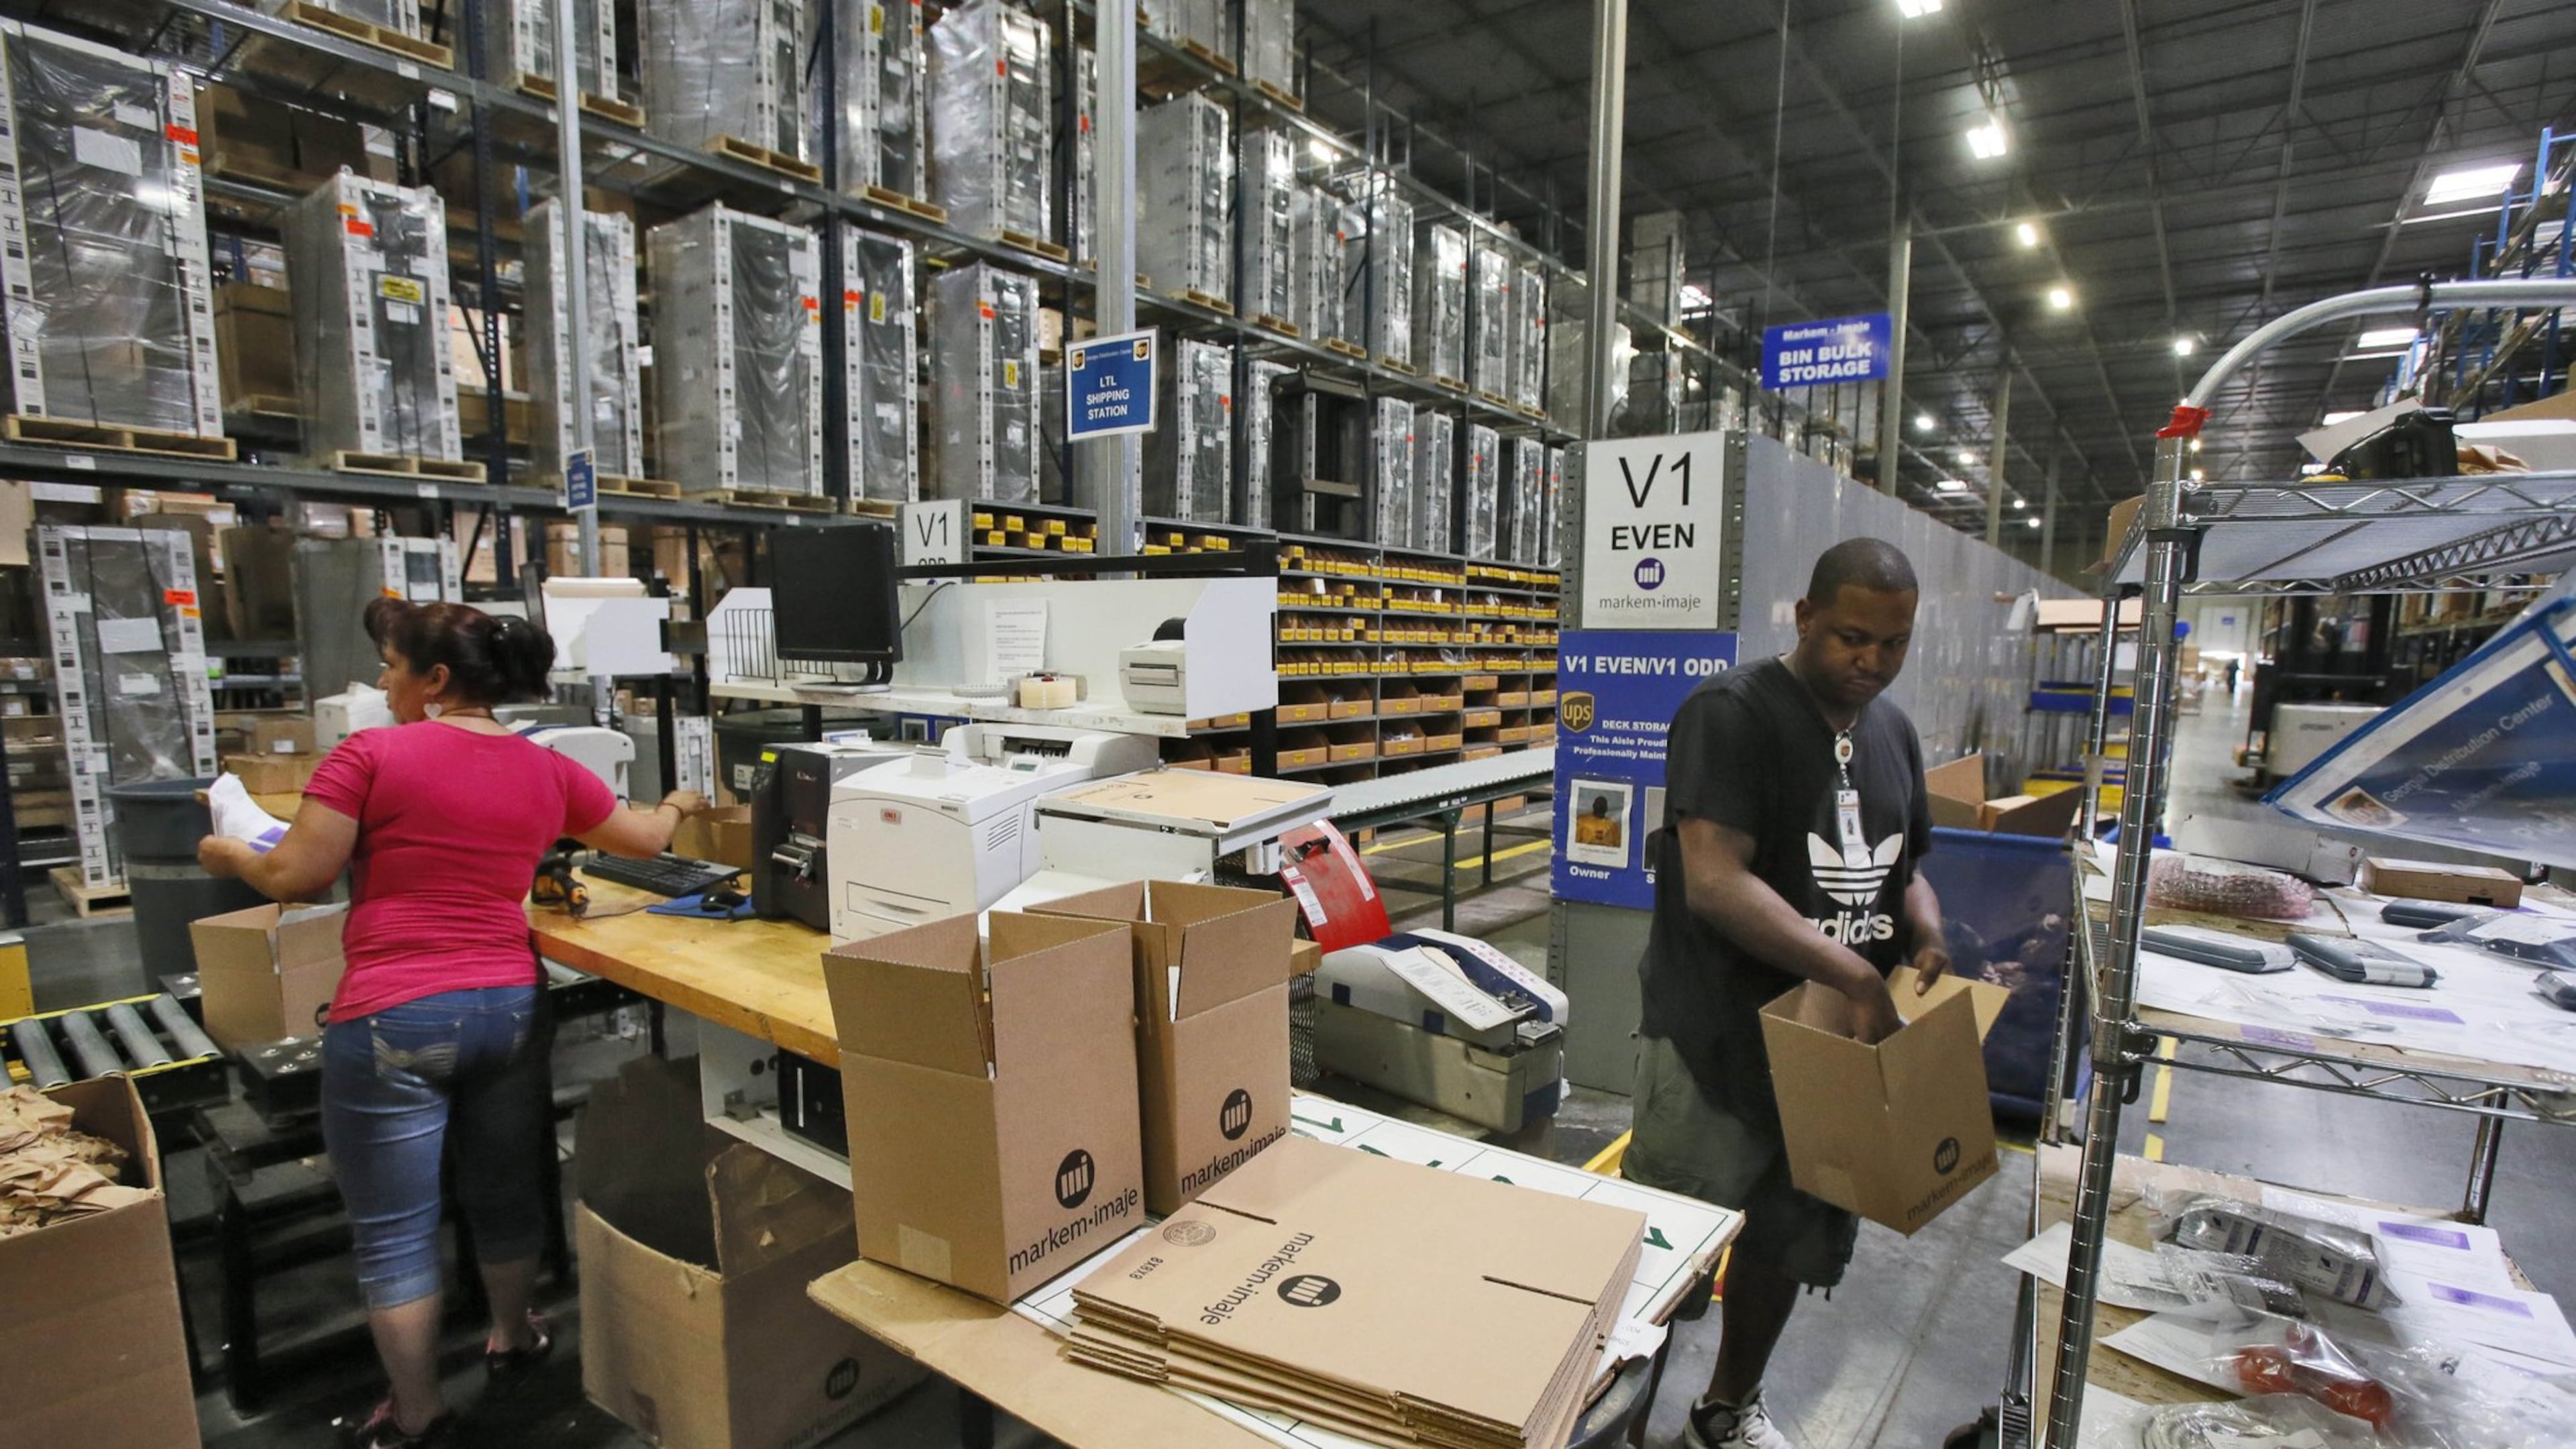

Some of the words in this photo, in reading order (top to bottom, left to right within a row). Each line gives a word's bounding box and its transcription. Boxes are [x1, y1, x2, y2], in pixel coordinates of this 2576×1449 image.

[1783, 327, 1827, 341] Markem
[1779, 349, 1813, 366] BIN
[1818, 341, 1872, 362] BULK
[1779, 360, 1870, 382] STORAGE
[1099, 376, 1117, 388] LTL
[1086, 389, 1129, 405] SHIPPING
[1087, 405, 1128, 420] STATION
[1619, 451, 1690, 508] V1
[916, 511, 947, 547] V1
[1612, 523, 1694, 550] EVEN
[1564, 655, 1587, 673] V1
[1595, 656, 1676, 675] EVEN/V1
[1684, 658, 1728, 676] ODD
[1563, 705, 1591, 727] ups
[1602, 720, 1629, 731] DECK
[1590, 735, 1609, 744] This
[1611, 737, 1635, 746] Aisle
[2383, 770, 2429, 804] Georgia
[2423, 726, 2501, 777] Distribution
[2499, 693, 2553, 732] Center
[1574, 747, 1637, 760] Professionally
[1569, 865, 1611, 880] Owner
